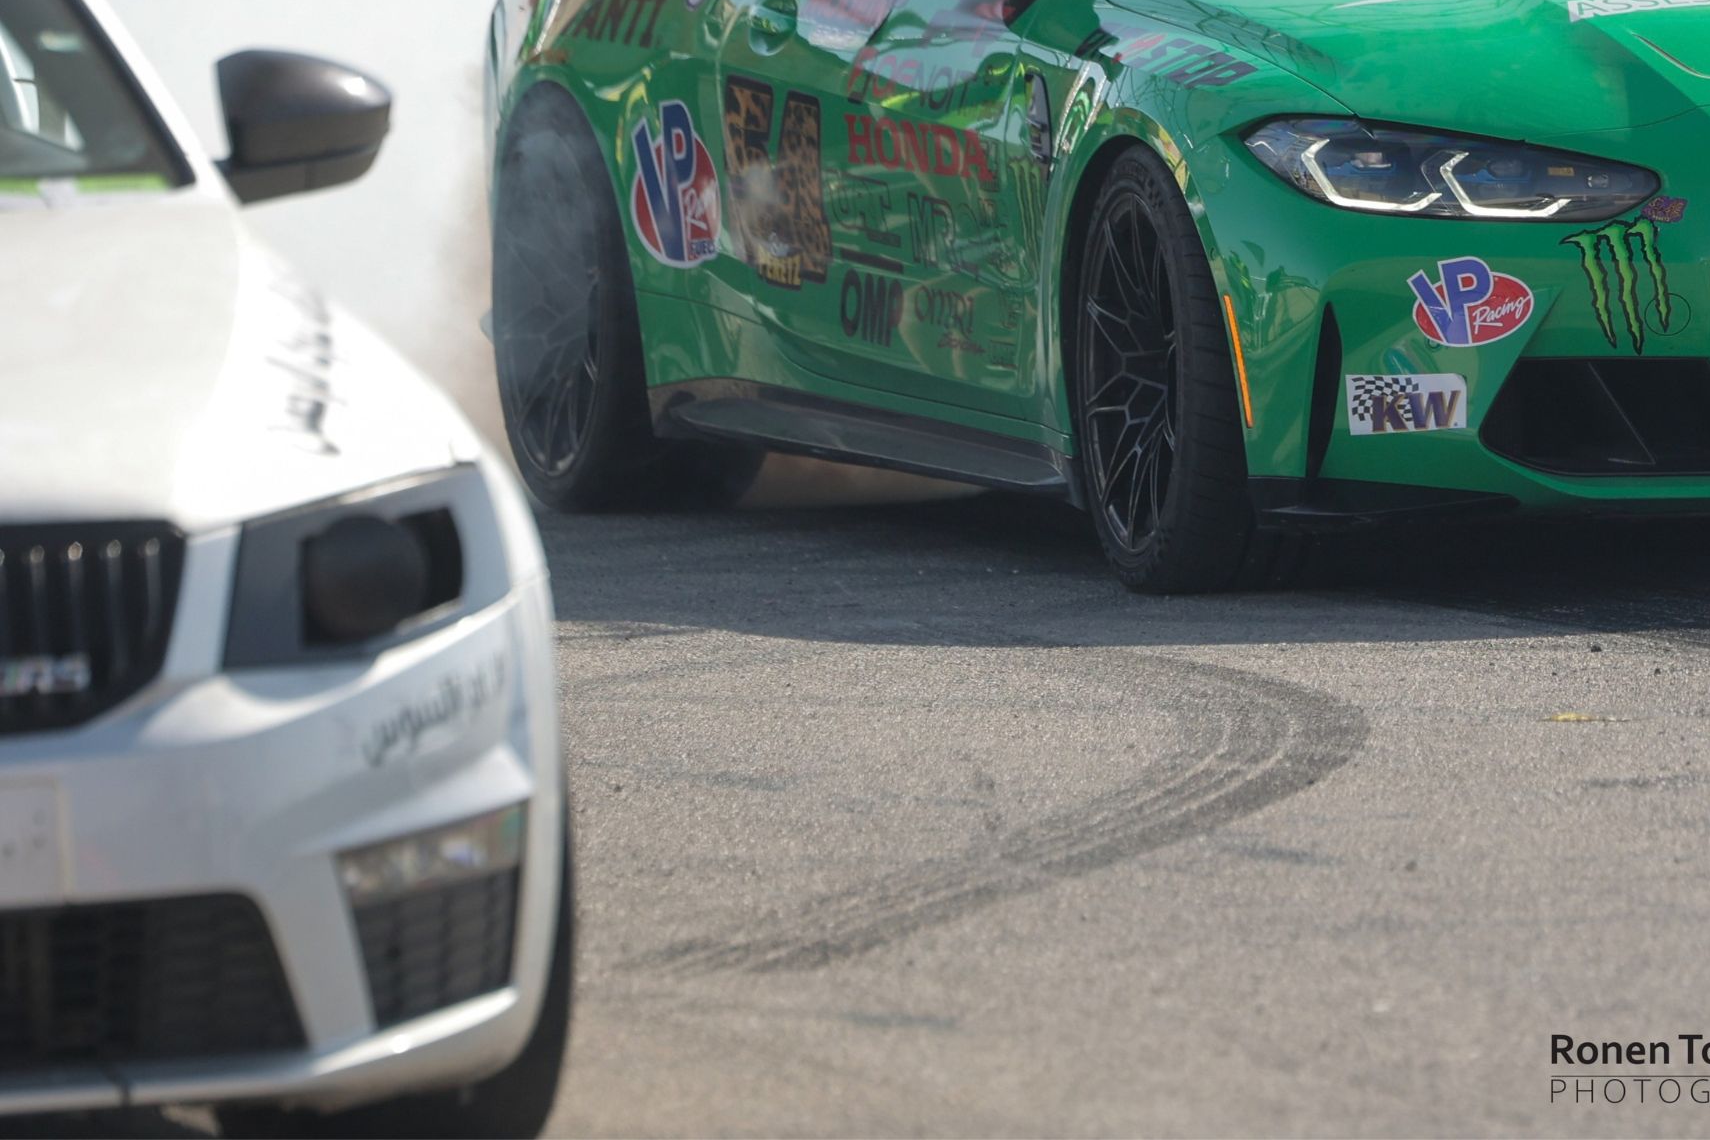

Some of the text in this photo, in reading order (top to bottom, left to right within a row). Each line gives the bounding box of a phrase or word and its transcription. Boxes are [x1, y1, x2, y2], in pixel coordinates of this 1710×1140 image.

[630, 99, 697, 262] VP
[844, 114, 994, 182] HONDA
[840, 268, 904, 348] OMP
[1407, 256, 1495, 347] VP
[1472, 294, 1532, 335] Racing
[1371, 389, 1461, 433] KW
